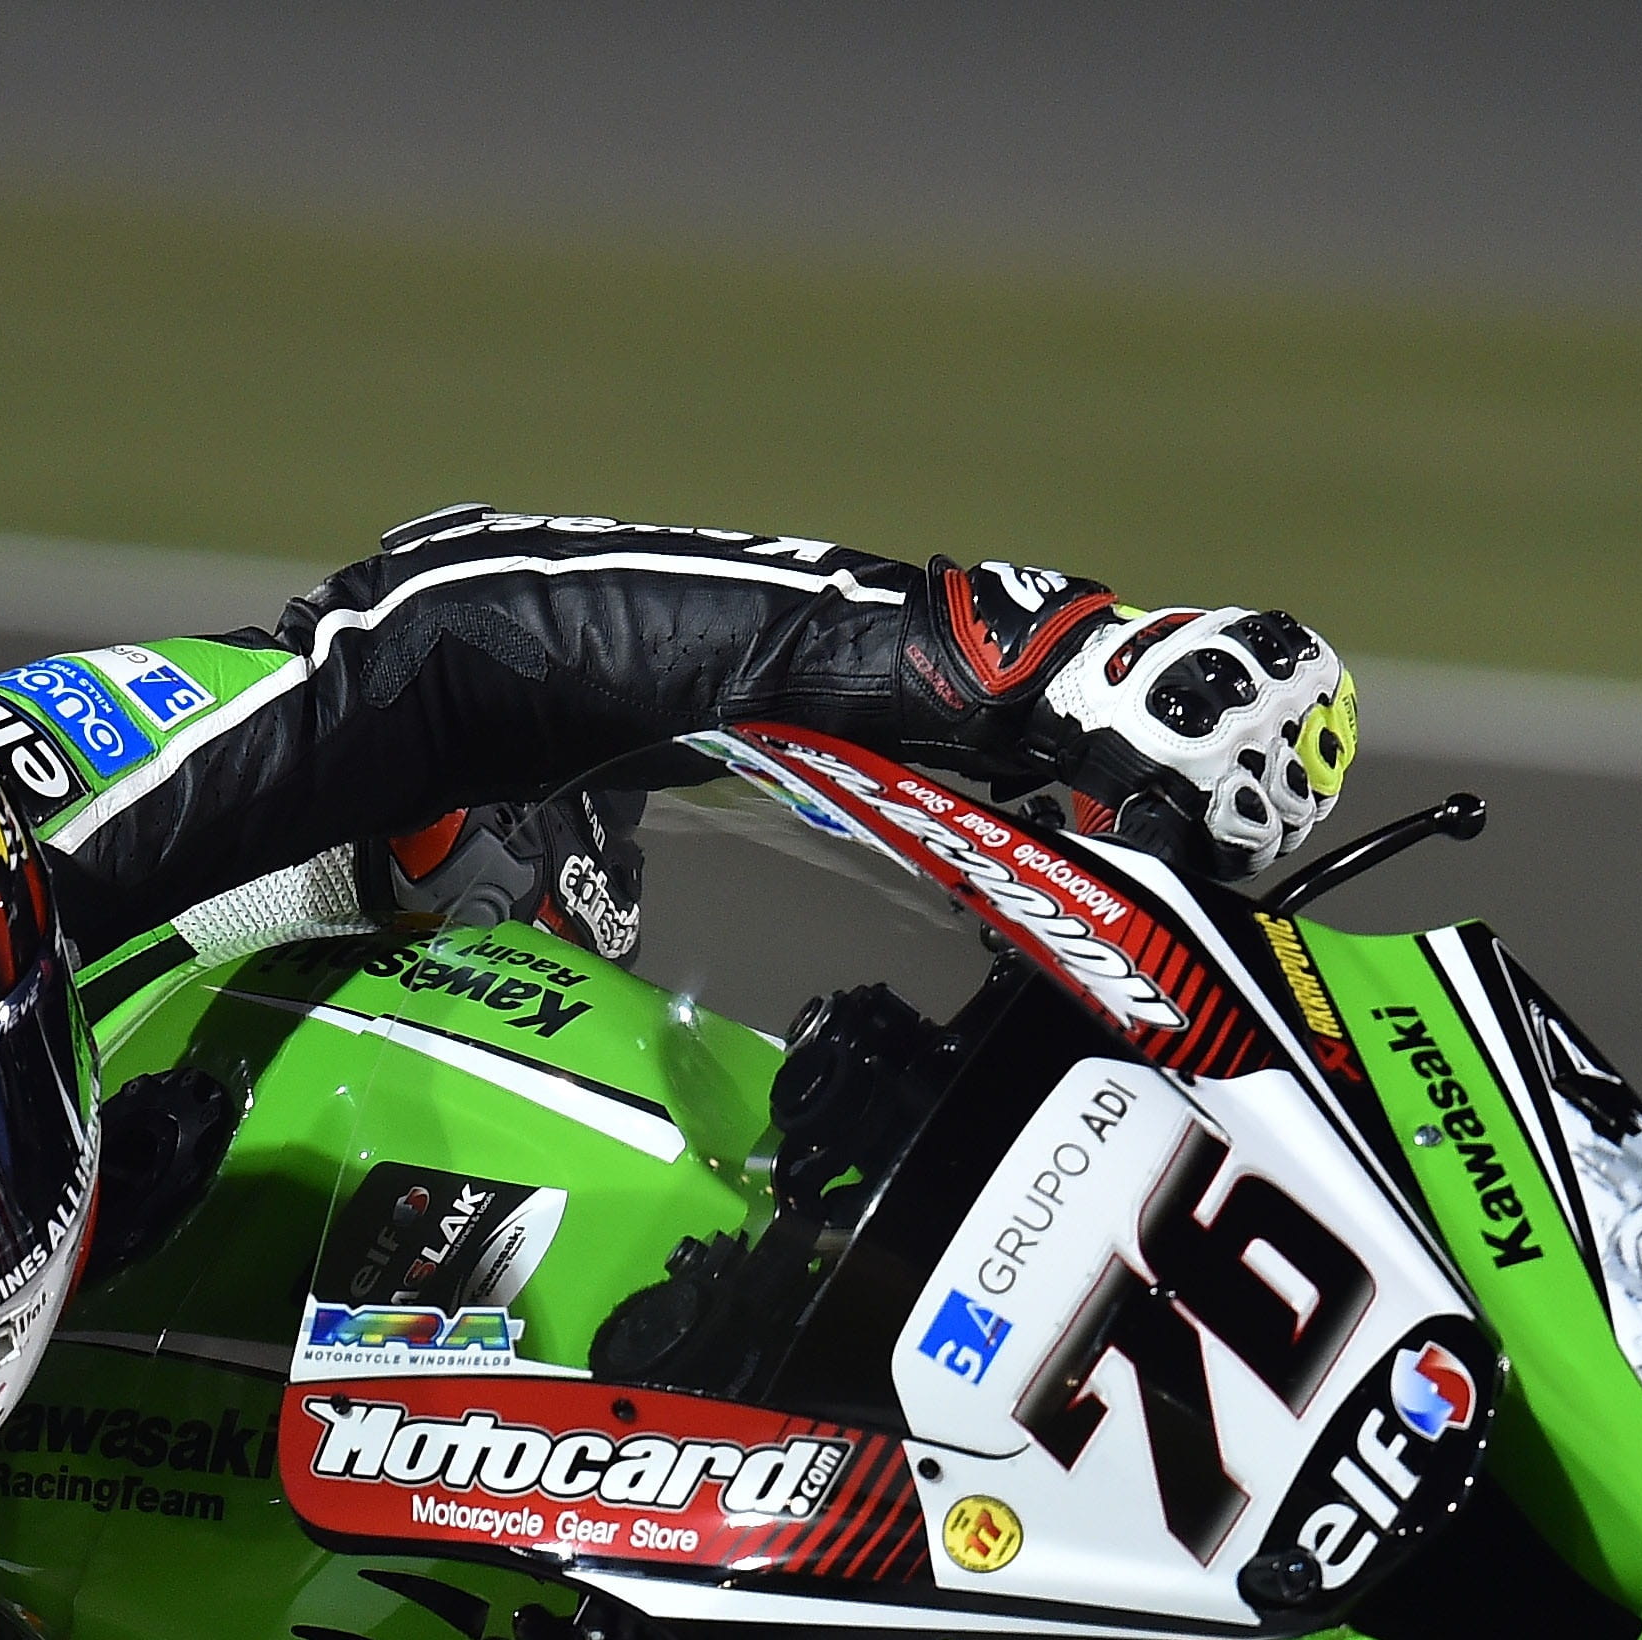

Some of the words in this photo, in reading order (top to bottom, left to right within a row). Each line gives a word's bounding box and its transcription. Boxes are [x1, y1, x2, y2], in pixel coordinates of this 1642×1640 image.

[896, 779, 957, 824] Store
[362, 949, 594, 1039] Kawas
[978, 1142, 1091, 1295] GRUPO
[1080, 1079, 1138, 1144] ADI
[1371, 1006, 1544, 1269] Kawasaki
[304, 1350, 402, 1366] MOTORCYCLE
[409, 1354, 512, 1367] WINDSHIELDS
[1011, 1118, 1376, 1567] 76
[308, 1400, 804, 1517] Motocard
[1297, 1408, 1422, 1590] elf
[412, 1493, 544, 1538] Motorcycle
[556, 1510, 618, 1545] Gear
[631, 1517, 698, 1552] Store
